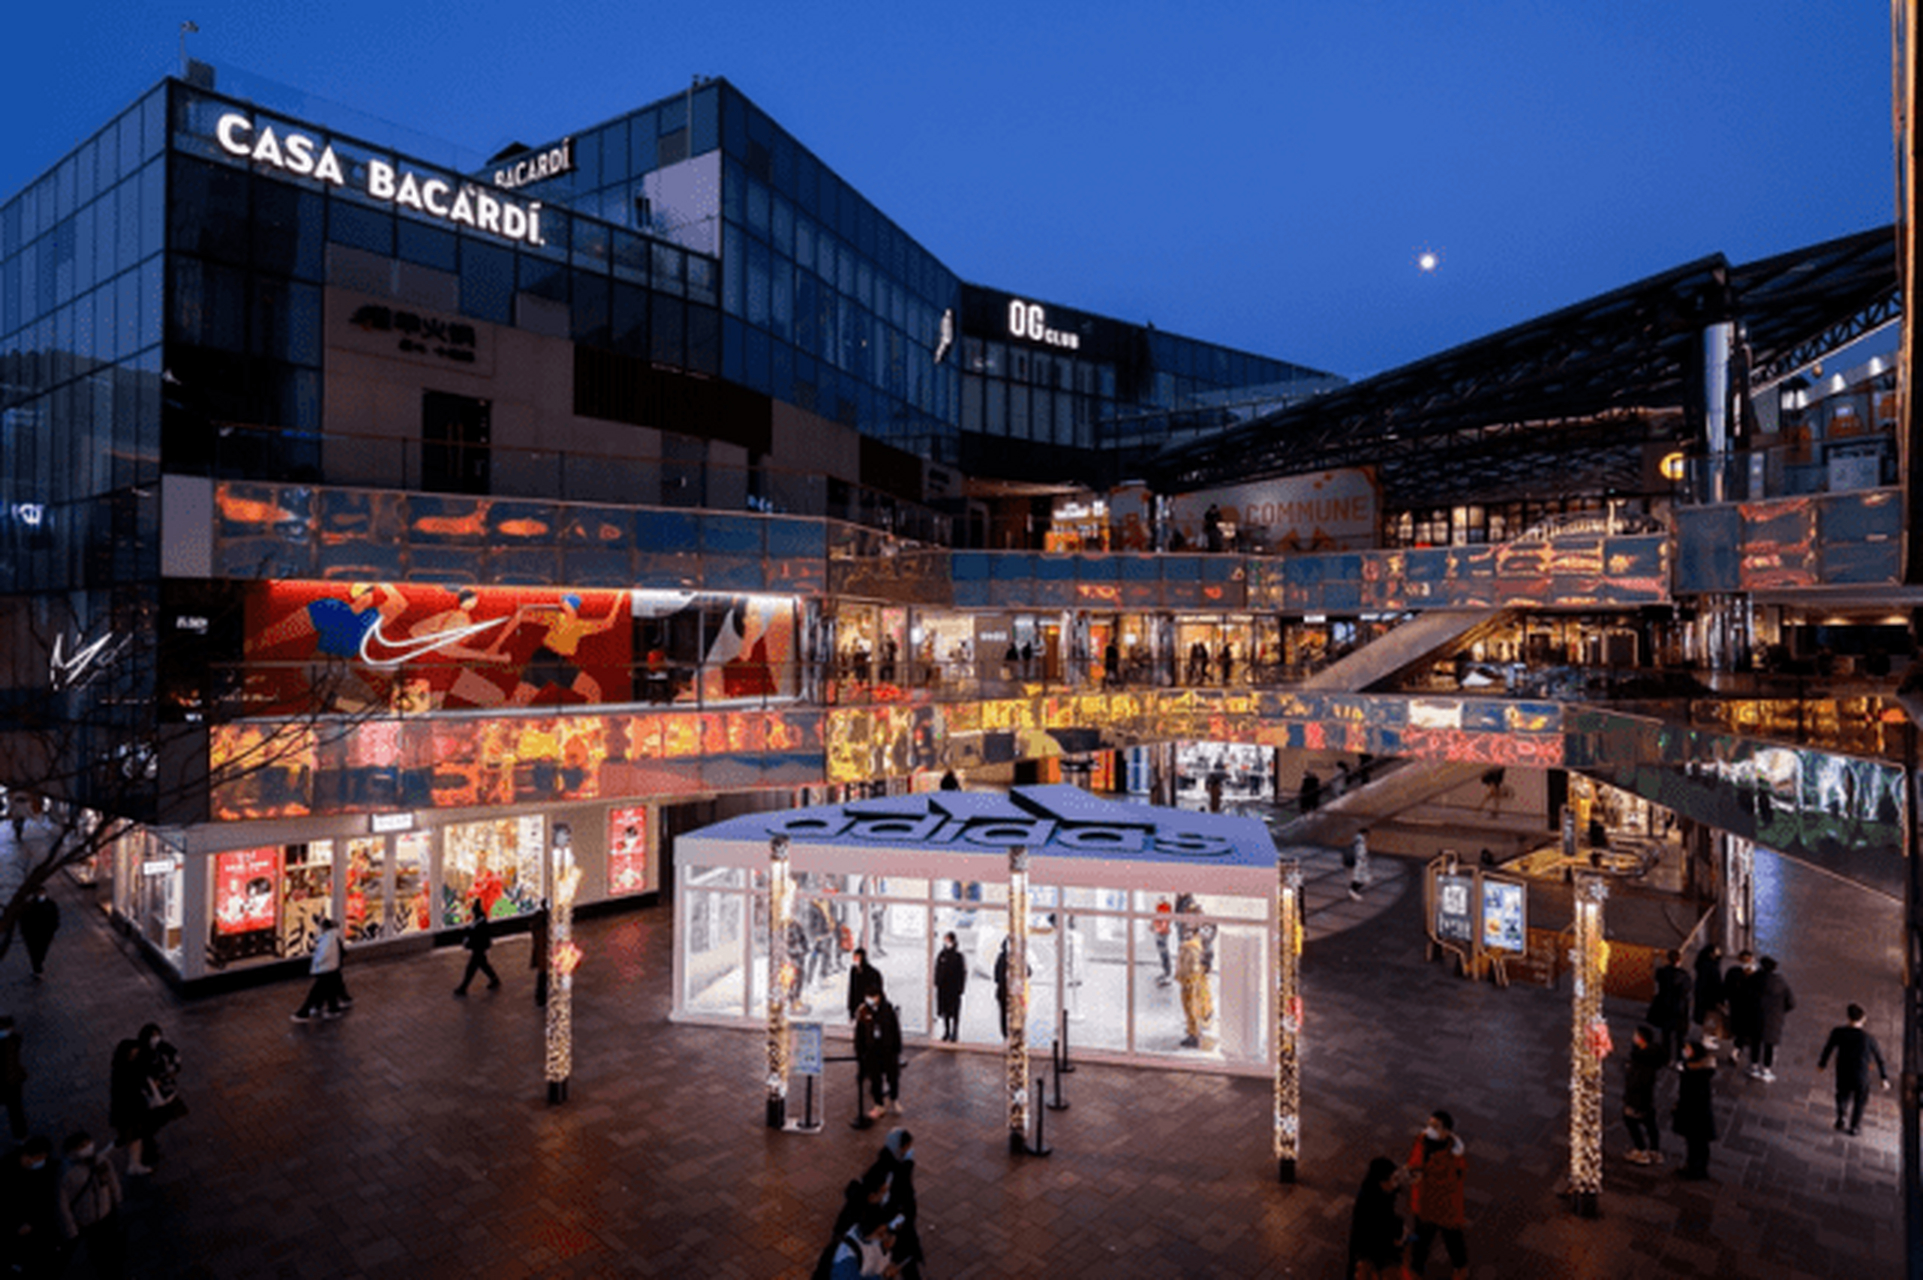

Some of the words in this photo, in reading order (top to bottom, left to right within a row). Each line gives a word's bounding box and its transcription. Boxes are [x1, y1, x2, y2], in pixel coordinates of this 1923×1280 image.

[216, 113, 345, 185] CASA
[1008, 299, 1045, 341] OG
[1044, 327, 1080, 350] CLUB
[1244, 495, 1368, 525] COMMUNE
[760, 785, 1233, 857] adidas
